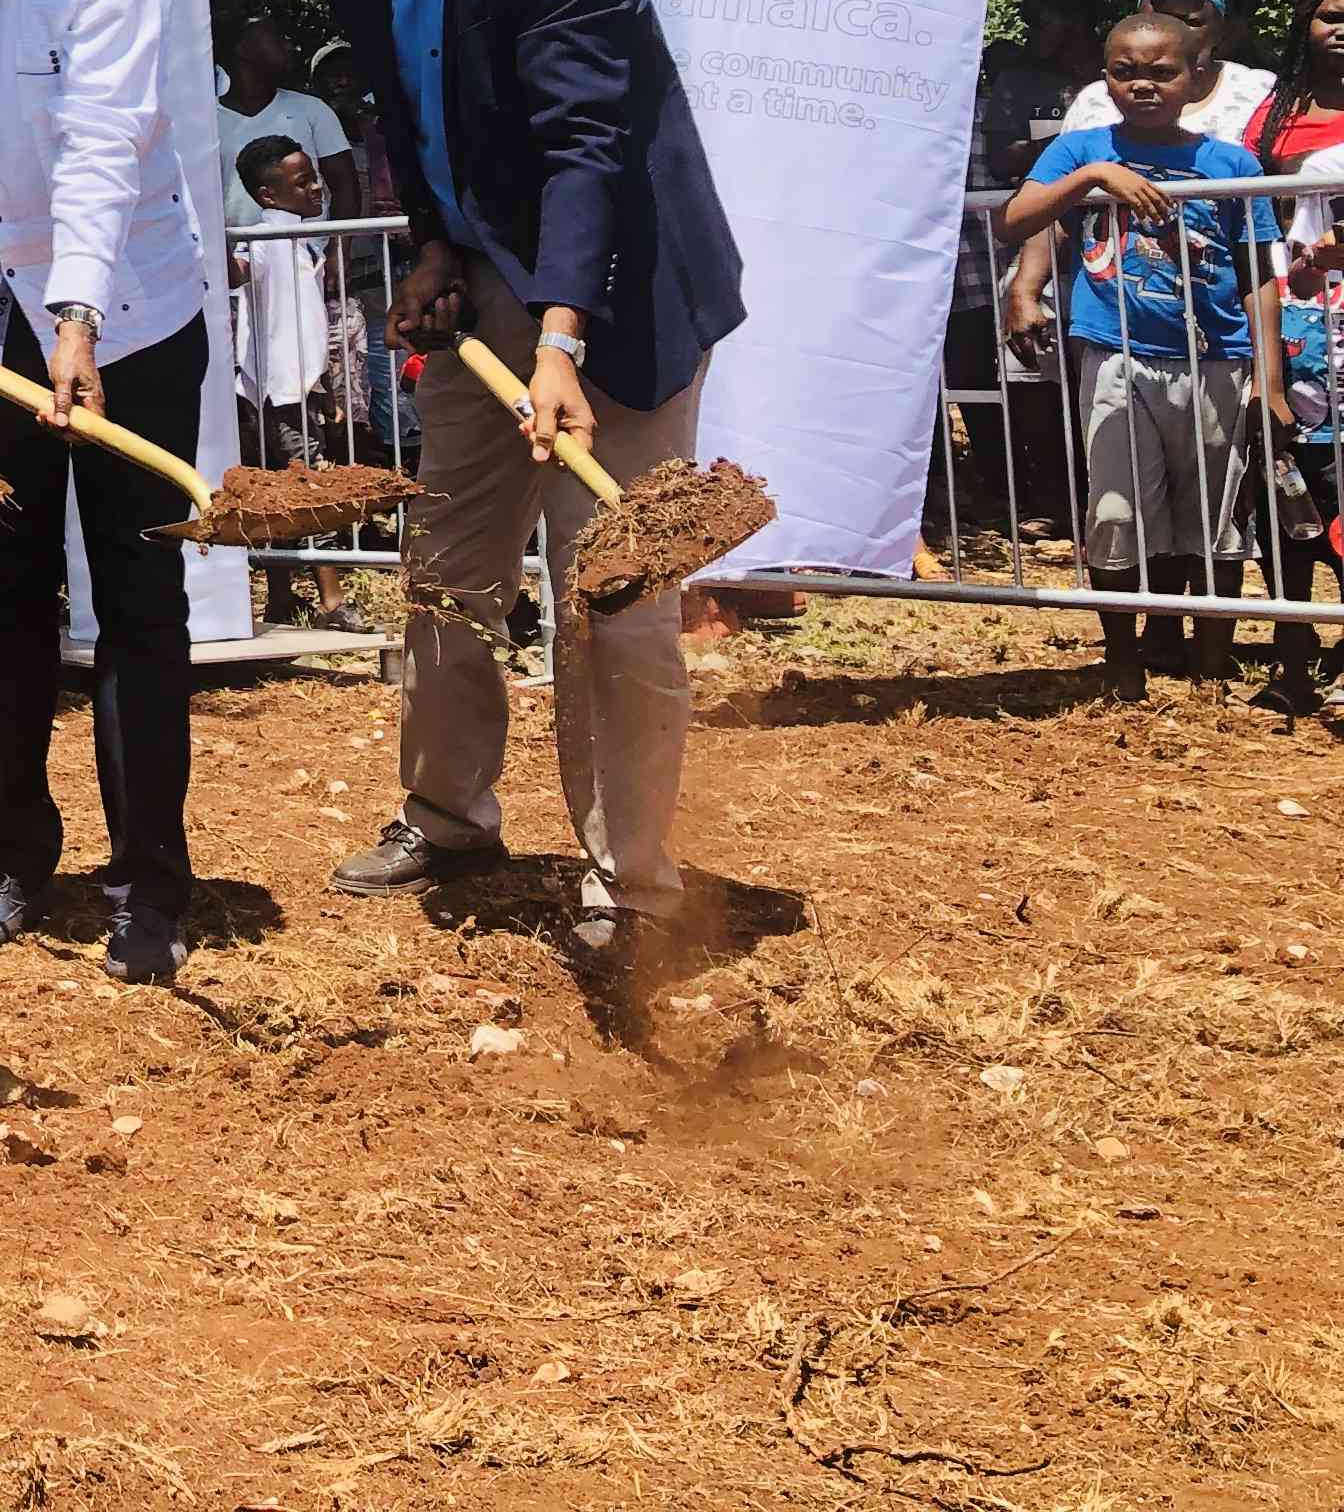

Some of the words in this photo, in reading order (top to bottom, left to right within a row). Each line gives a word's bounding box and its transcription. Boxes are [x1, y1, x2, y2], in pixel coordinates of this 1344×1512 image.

[699, 48, 950, 113] community
[726, 88, 753, 114] a
[763, 86, 877, 130] time.
